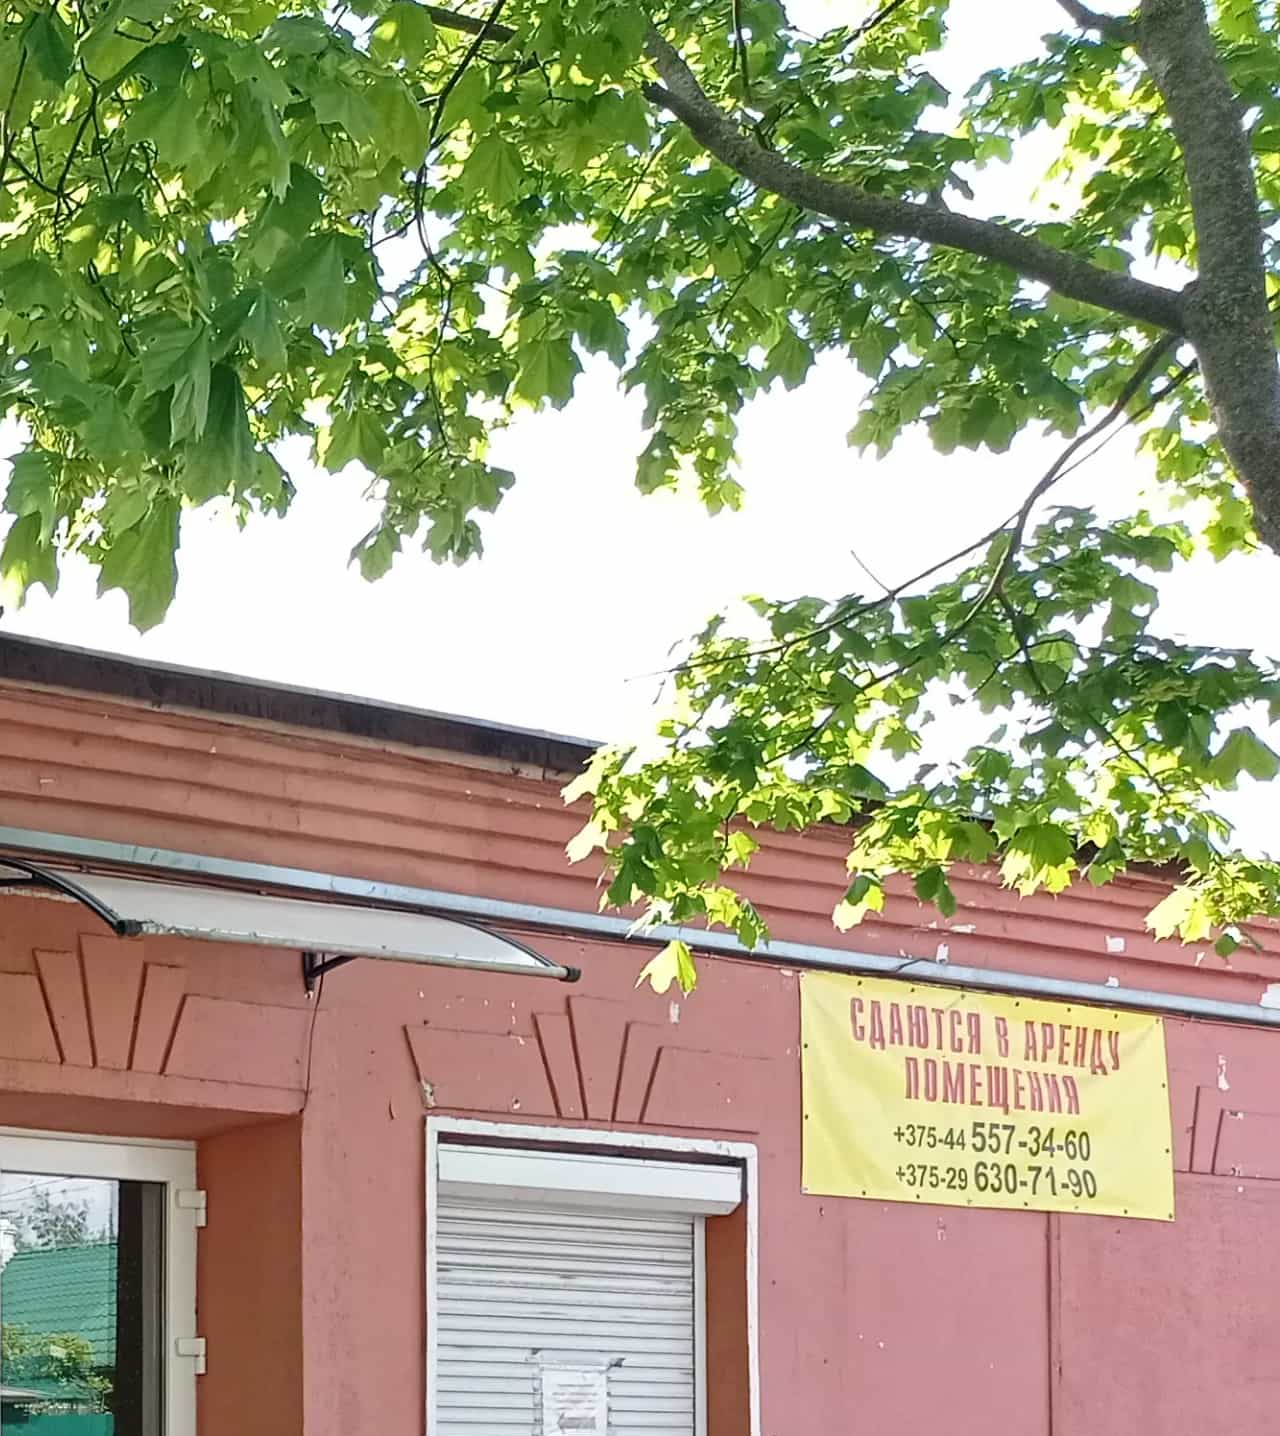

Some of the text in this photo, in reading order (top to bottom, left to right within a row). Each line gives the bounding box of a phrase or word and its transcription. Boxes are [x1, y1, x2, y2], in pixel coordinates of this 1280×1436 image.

[850, 997, 1121, 1076] СДАЮТСЯ В АРЕНДУ
[905, 1056, 1080, 1115] ПОМЕЩЕНИЯ
[893, 1122, 1091, 1161] +375-44 557-34-60
[896, 1161, 1098, 1199] +375-29 630-71-90
